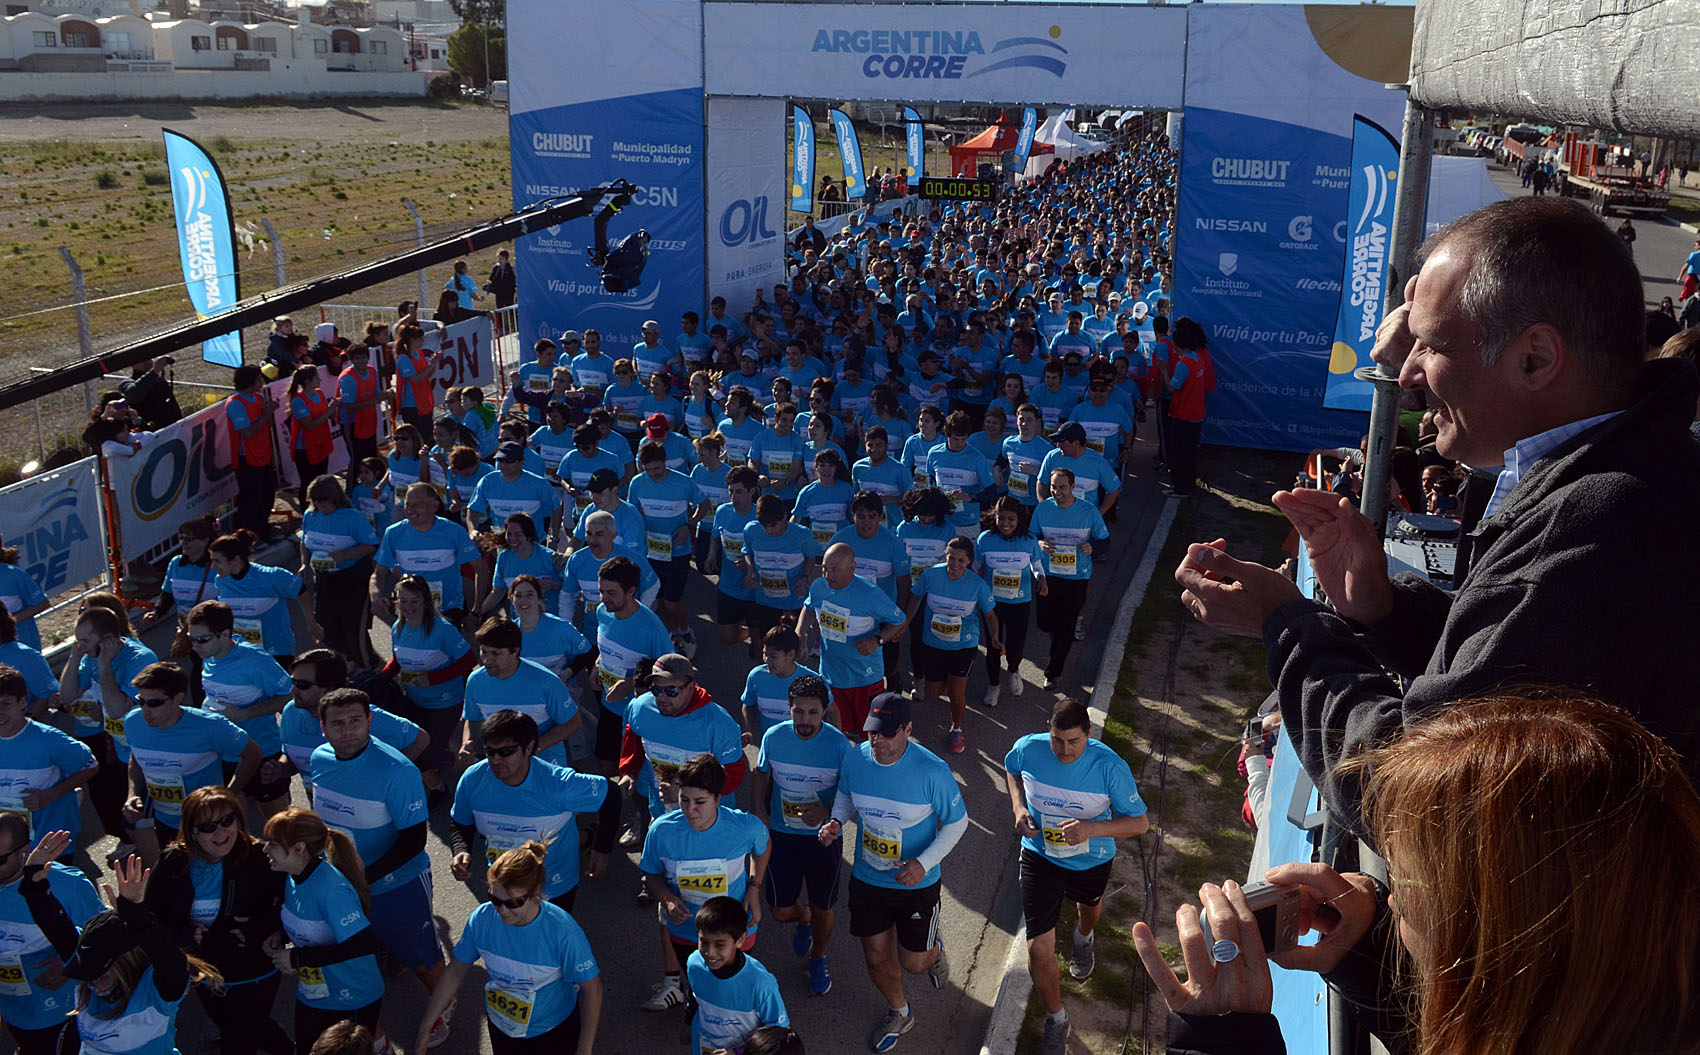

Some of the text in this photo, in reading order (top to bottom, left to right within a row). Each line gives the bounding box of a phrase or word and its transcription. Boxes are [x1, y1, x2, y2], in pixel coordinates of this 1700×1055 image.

[811, 28, 986, 55] ARGENTINA
[863, 54, 968, 80] CORRE
[532, 132, 594, 152] CHUBUT
[613, 141, 692, 155] Municipalidad
[620, 153, 651, 164] Puerto
[652, 155, 690, 166] Madryn
[1211, 156, 1291, 180] CHUBUT
[1195, 217, 1267, 233] NISSAN
[1279, 241, 1319, 251] GATORADE
[726, 269, 745, 282] PURA
[547, 280, 575, 295] Viajá
[579, 283, 599, 297] por
[1204, 276, 1250, 290] Instituto
[1213, 324, 1329, 346] Viajá por tu País
[1050, 554, 1075, 564] 2305
[994, 576, 1019, 587] 2025
[1034, 793, 1069, 805] ARGENTINA
[1043, 800, 1064, 809] CORRE
[864, 834, 899, 854] 2691
[679, 877, 724, 888] 2147
[340, 911, 361, 926] C5N
[576, 959, 594, 972] C5N
[487, 990, 529, 1019] 3621
